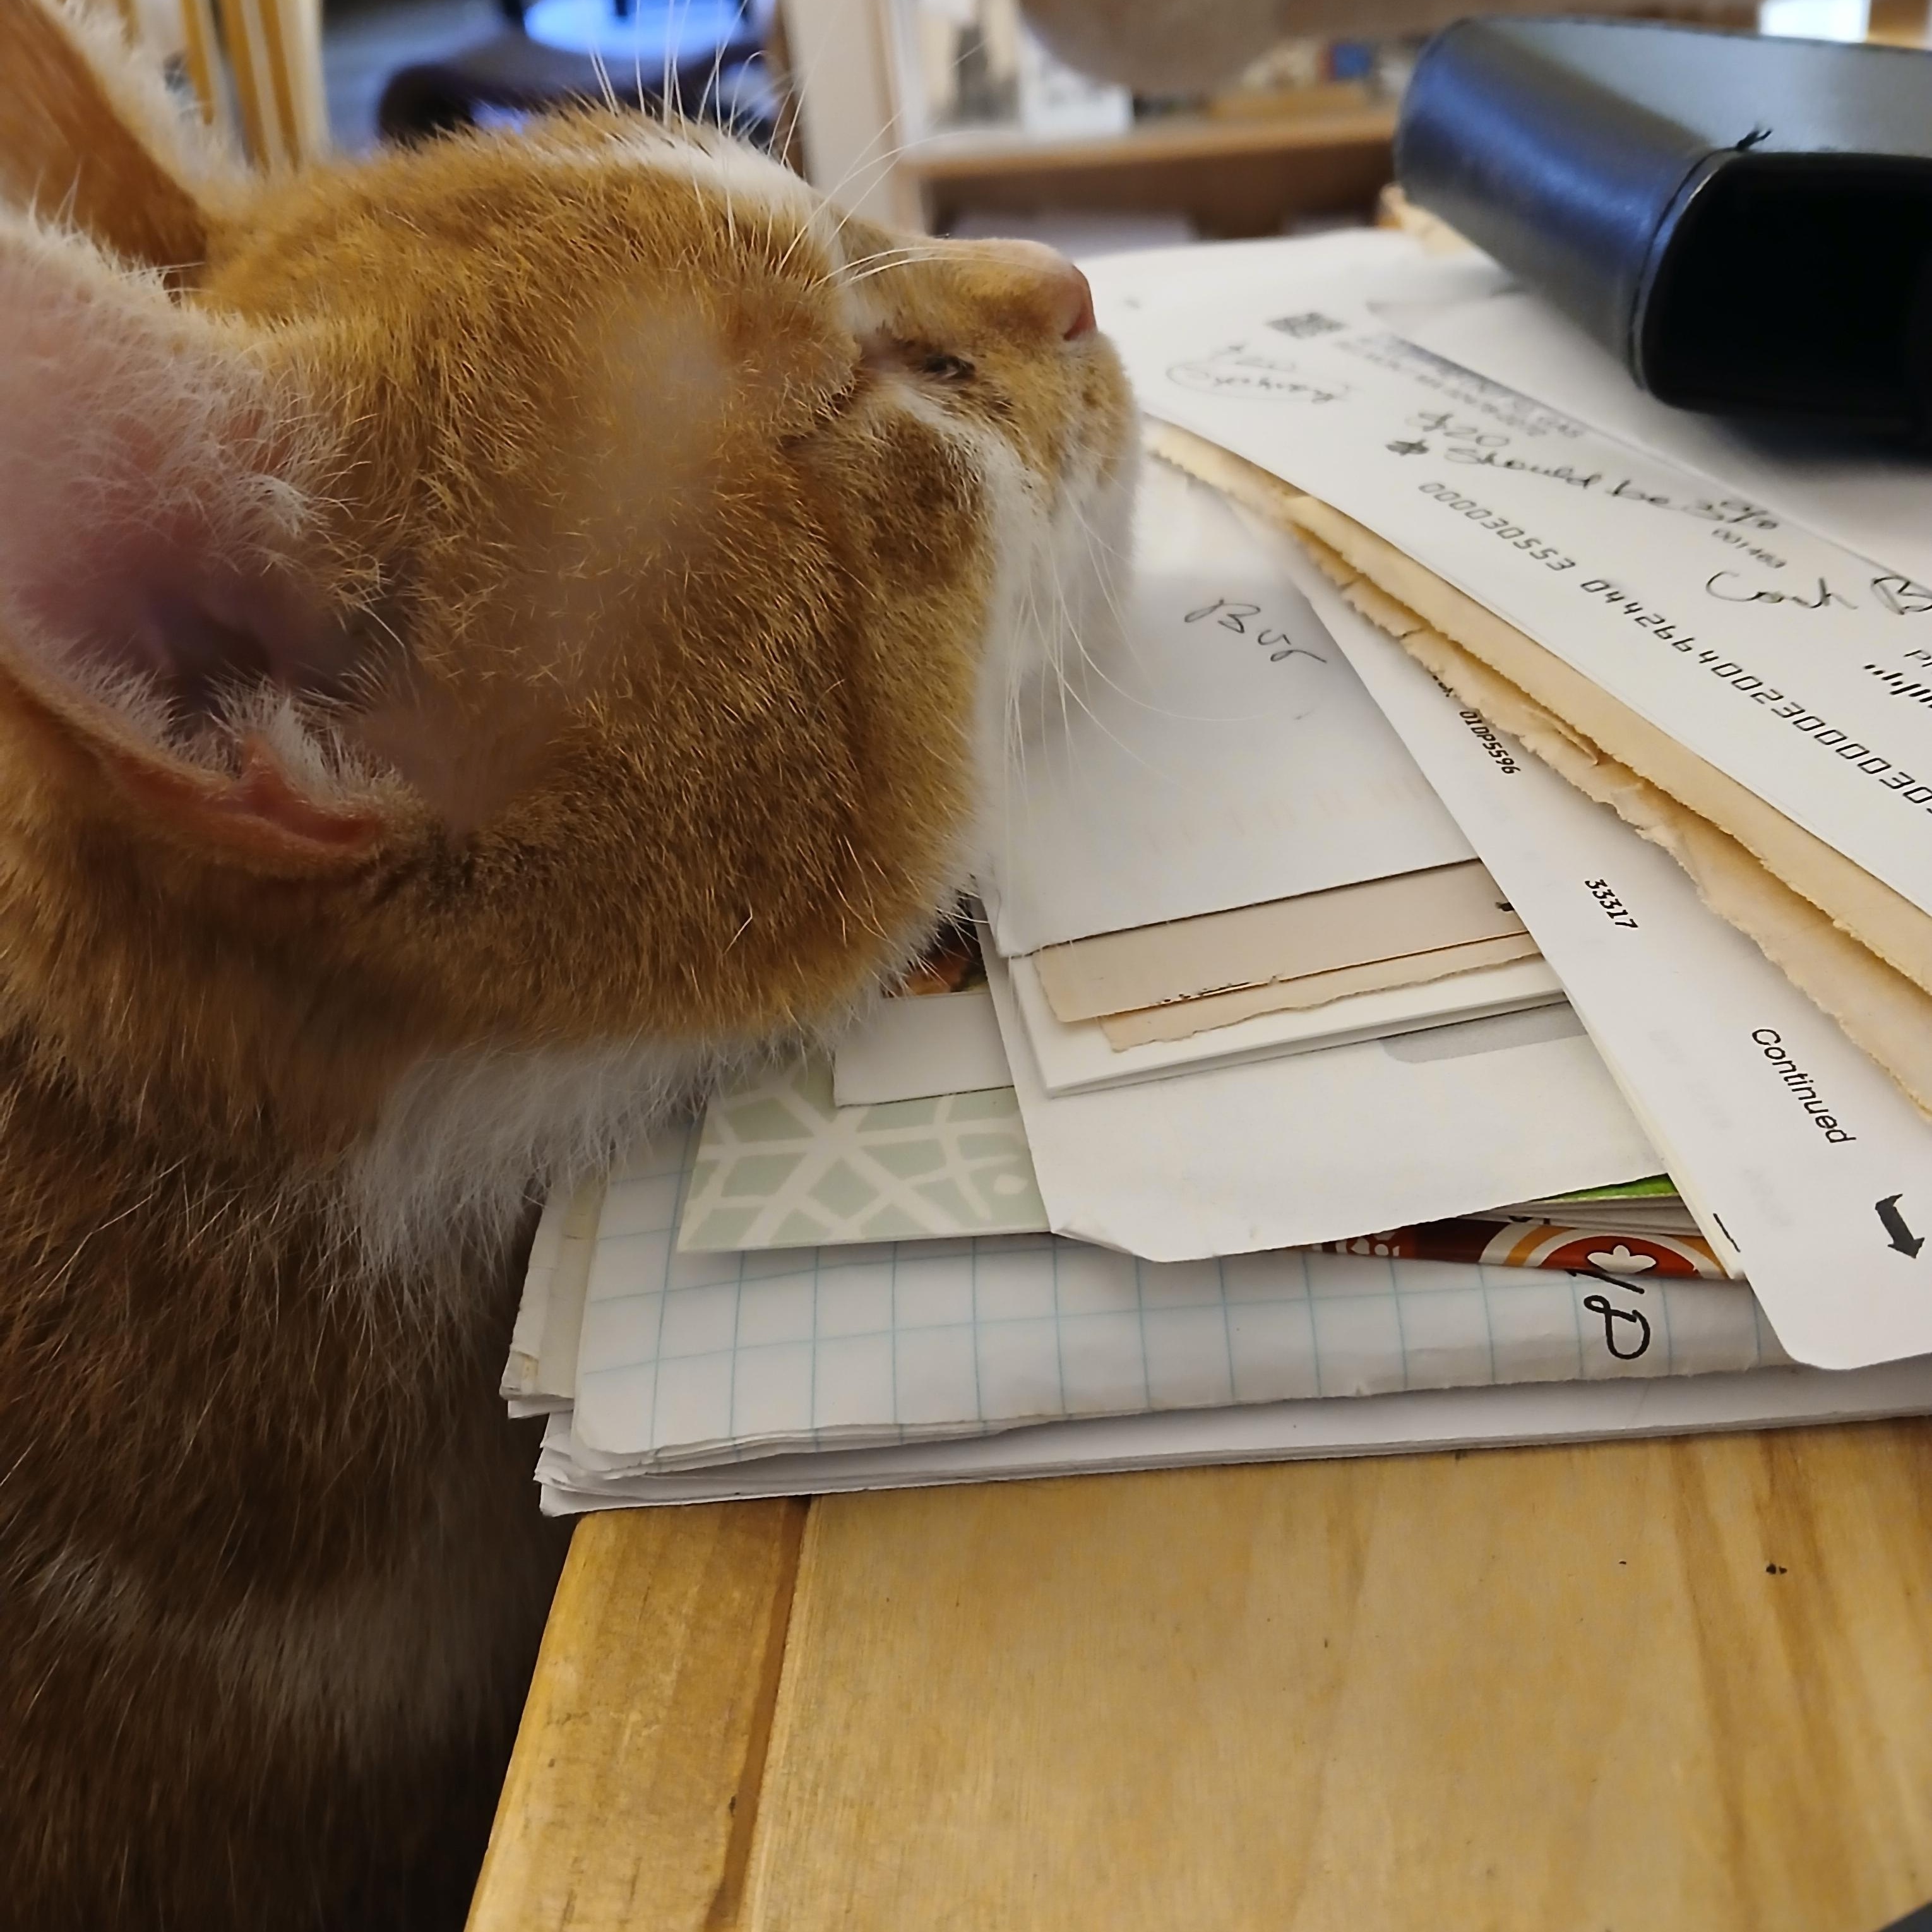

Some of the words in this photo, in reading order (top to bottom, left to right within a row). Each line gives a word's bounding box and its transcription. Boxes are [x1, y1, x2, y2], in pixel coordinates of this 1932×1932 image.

[1418, 482, 1577, 571] 000030553
[1580, 579, 1932, 816] 04426640023000030
[1584, 877, 1639, 929] 33317
[1751, 1028, 1857, 1144] Continued
